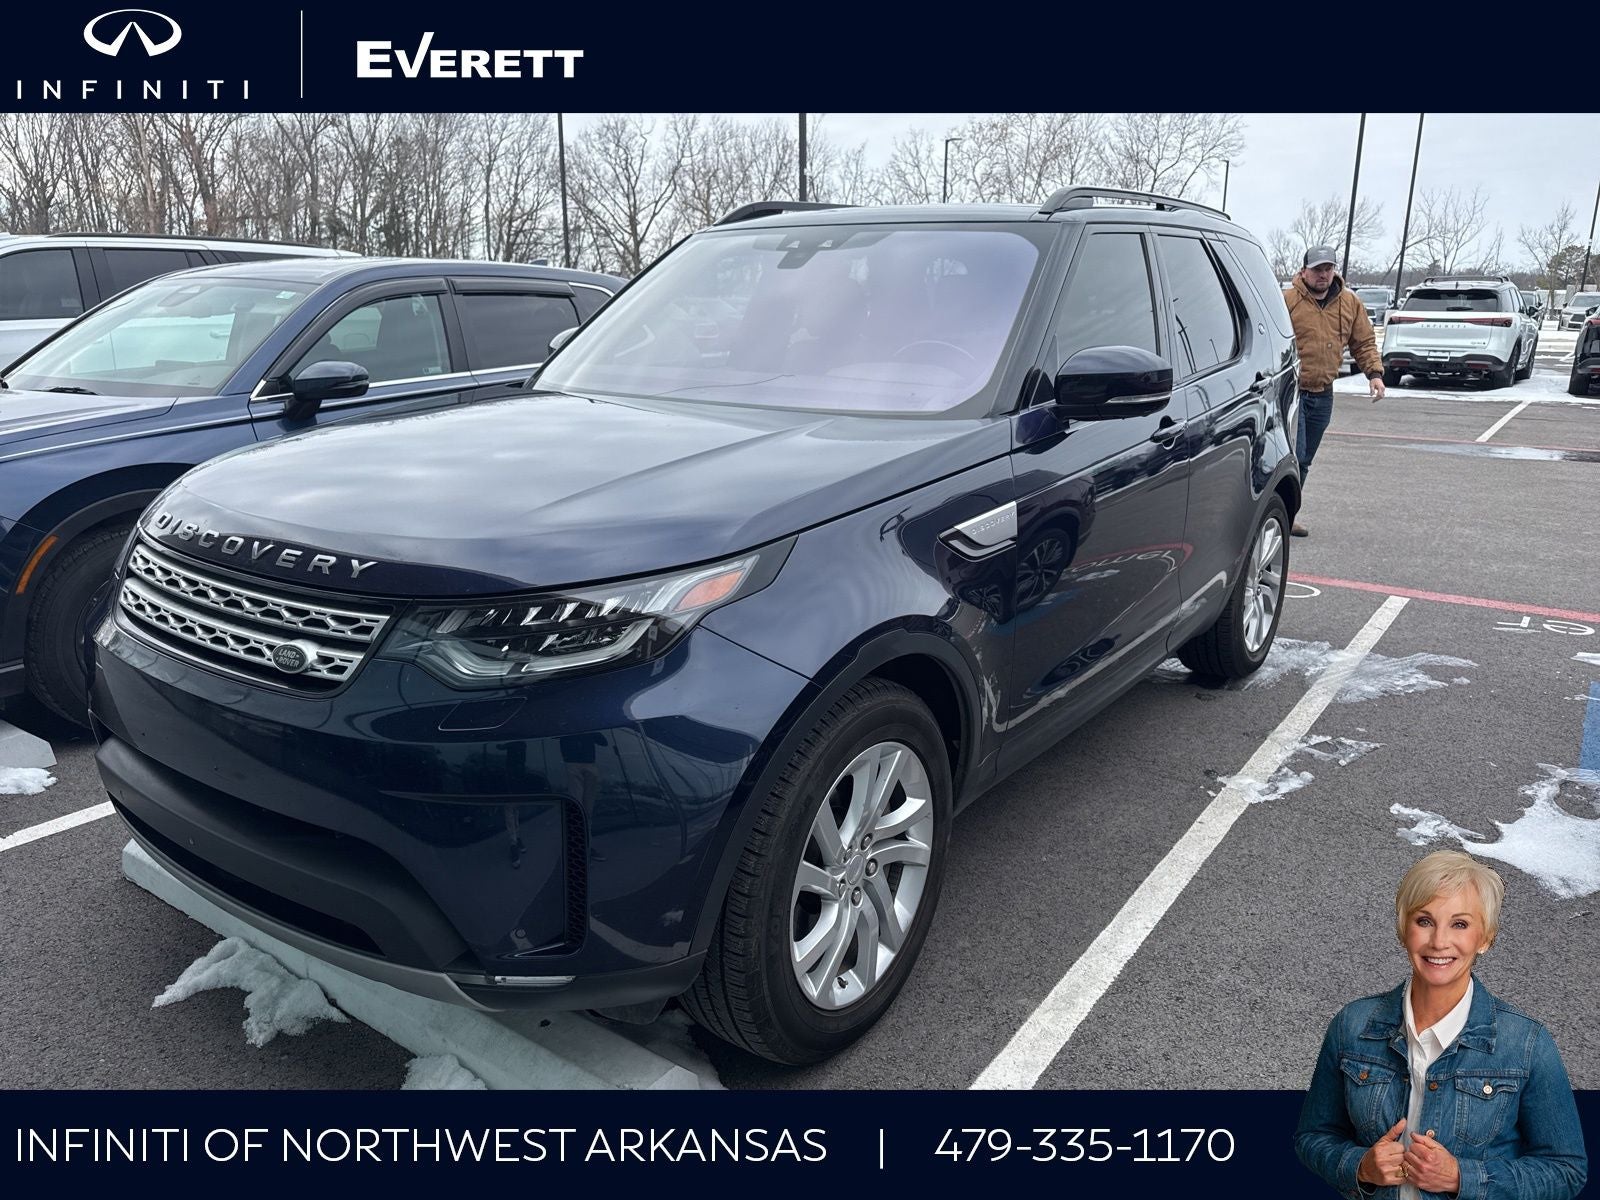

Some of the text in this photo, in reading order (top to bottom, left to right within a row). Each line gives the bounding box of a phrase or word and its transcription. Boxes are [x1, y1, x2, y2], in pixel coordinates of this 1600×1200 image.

[971, 511, 1016, 535] DISCOVERY
[154, 511, 378, 579] DISCOVERY
[279, 649, 297, 659] LAND
[279, 657, 300, 668] ROVER
